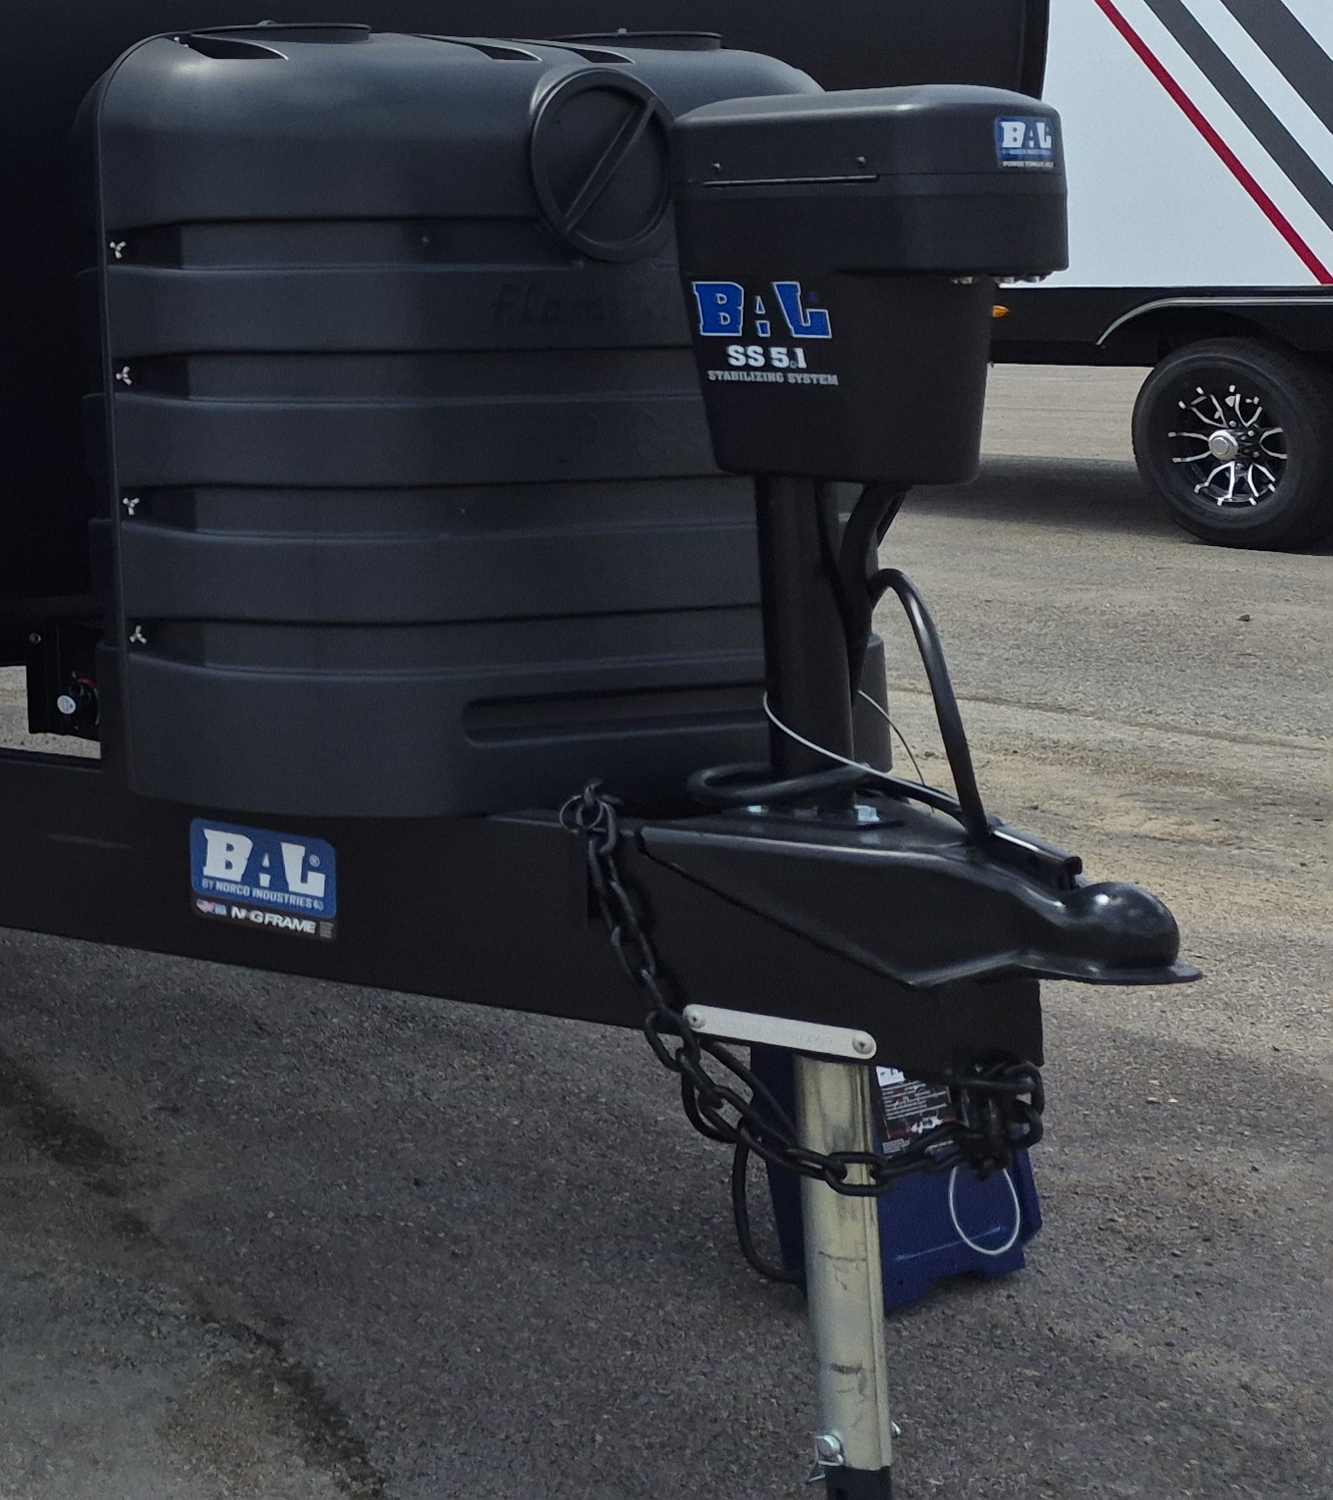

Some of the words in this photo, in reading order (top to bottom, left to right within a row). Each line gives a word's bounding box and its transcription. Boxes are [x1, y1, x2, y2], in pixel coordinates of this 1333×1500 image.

[1000, 121, 1052, 149] BAL
[692, 281, 832, 339] BAL
[727, 344, 766, 368] SS
[769, 347, 807, 369] 5.1
[707, 370, 784, 383] STABILIZING
[787, 372, 839, 386] SYSTEM
[202, 828, 326, 898] BAL
[202, 878, 213, 890] BY
[215, 881, 251, 897] NORCO
[252, 886, 313, 910] INDUSTRIES
[264, 912, 317, 934] FRAME
